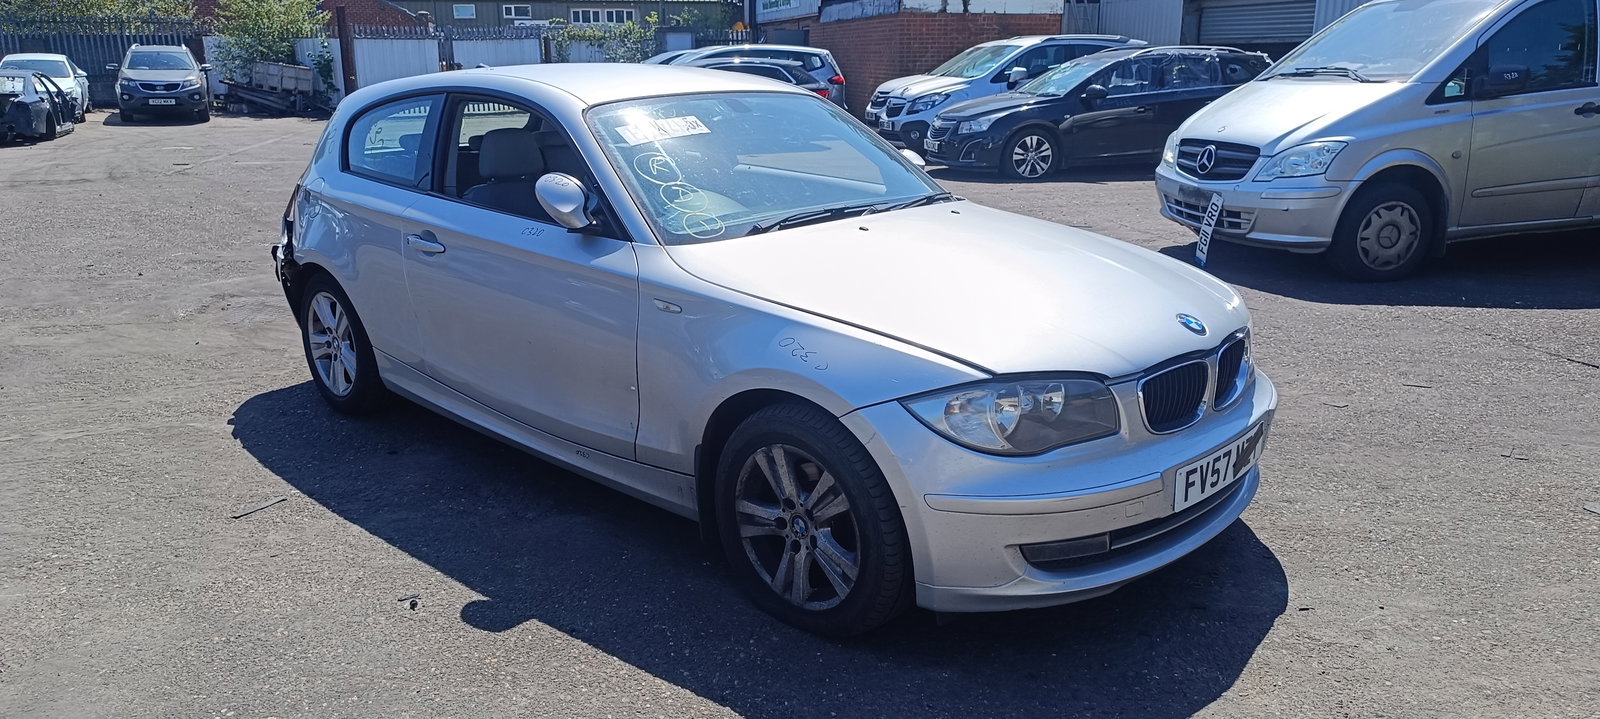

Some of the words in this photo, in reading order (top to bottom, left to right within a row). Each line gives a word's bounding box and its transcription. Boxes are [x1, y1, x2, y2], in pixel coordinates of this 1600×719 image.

[521, 227, 545, 237] C320
[1197, 229, 1210, 255] FG11
[1204, 202, 1220, 229] VRO
[1183, 448, 1233, 503] FV57
